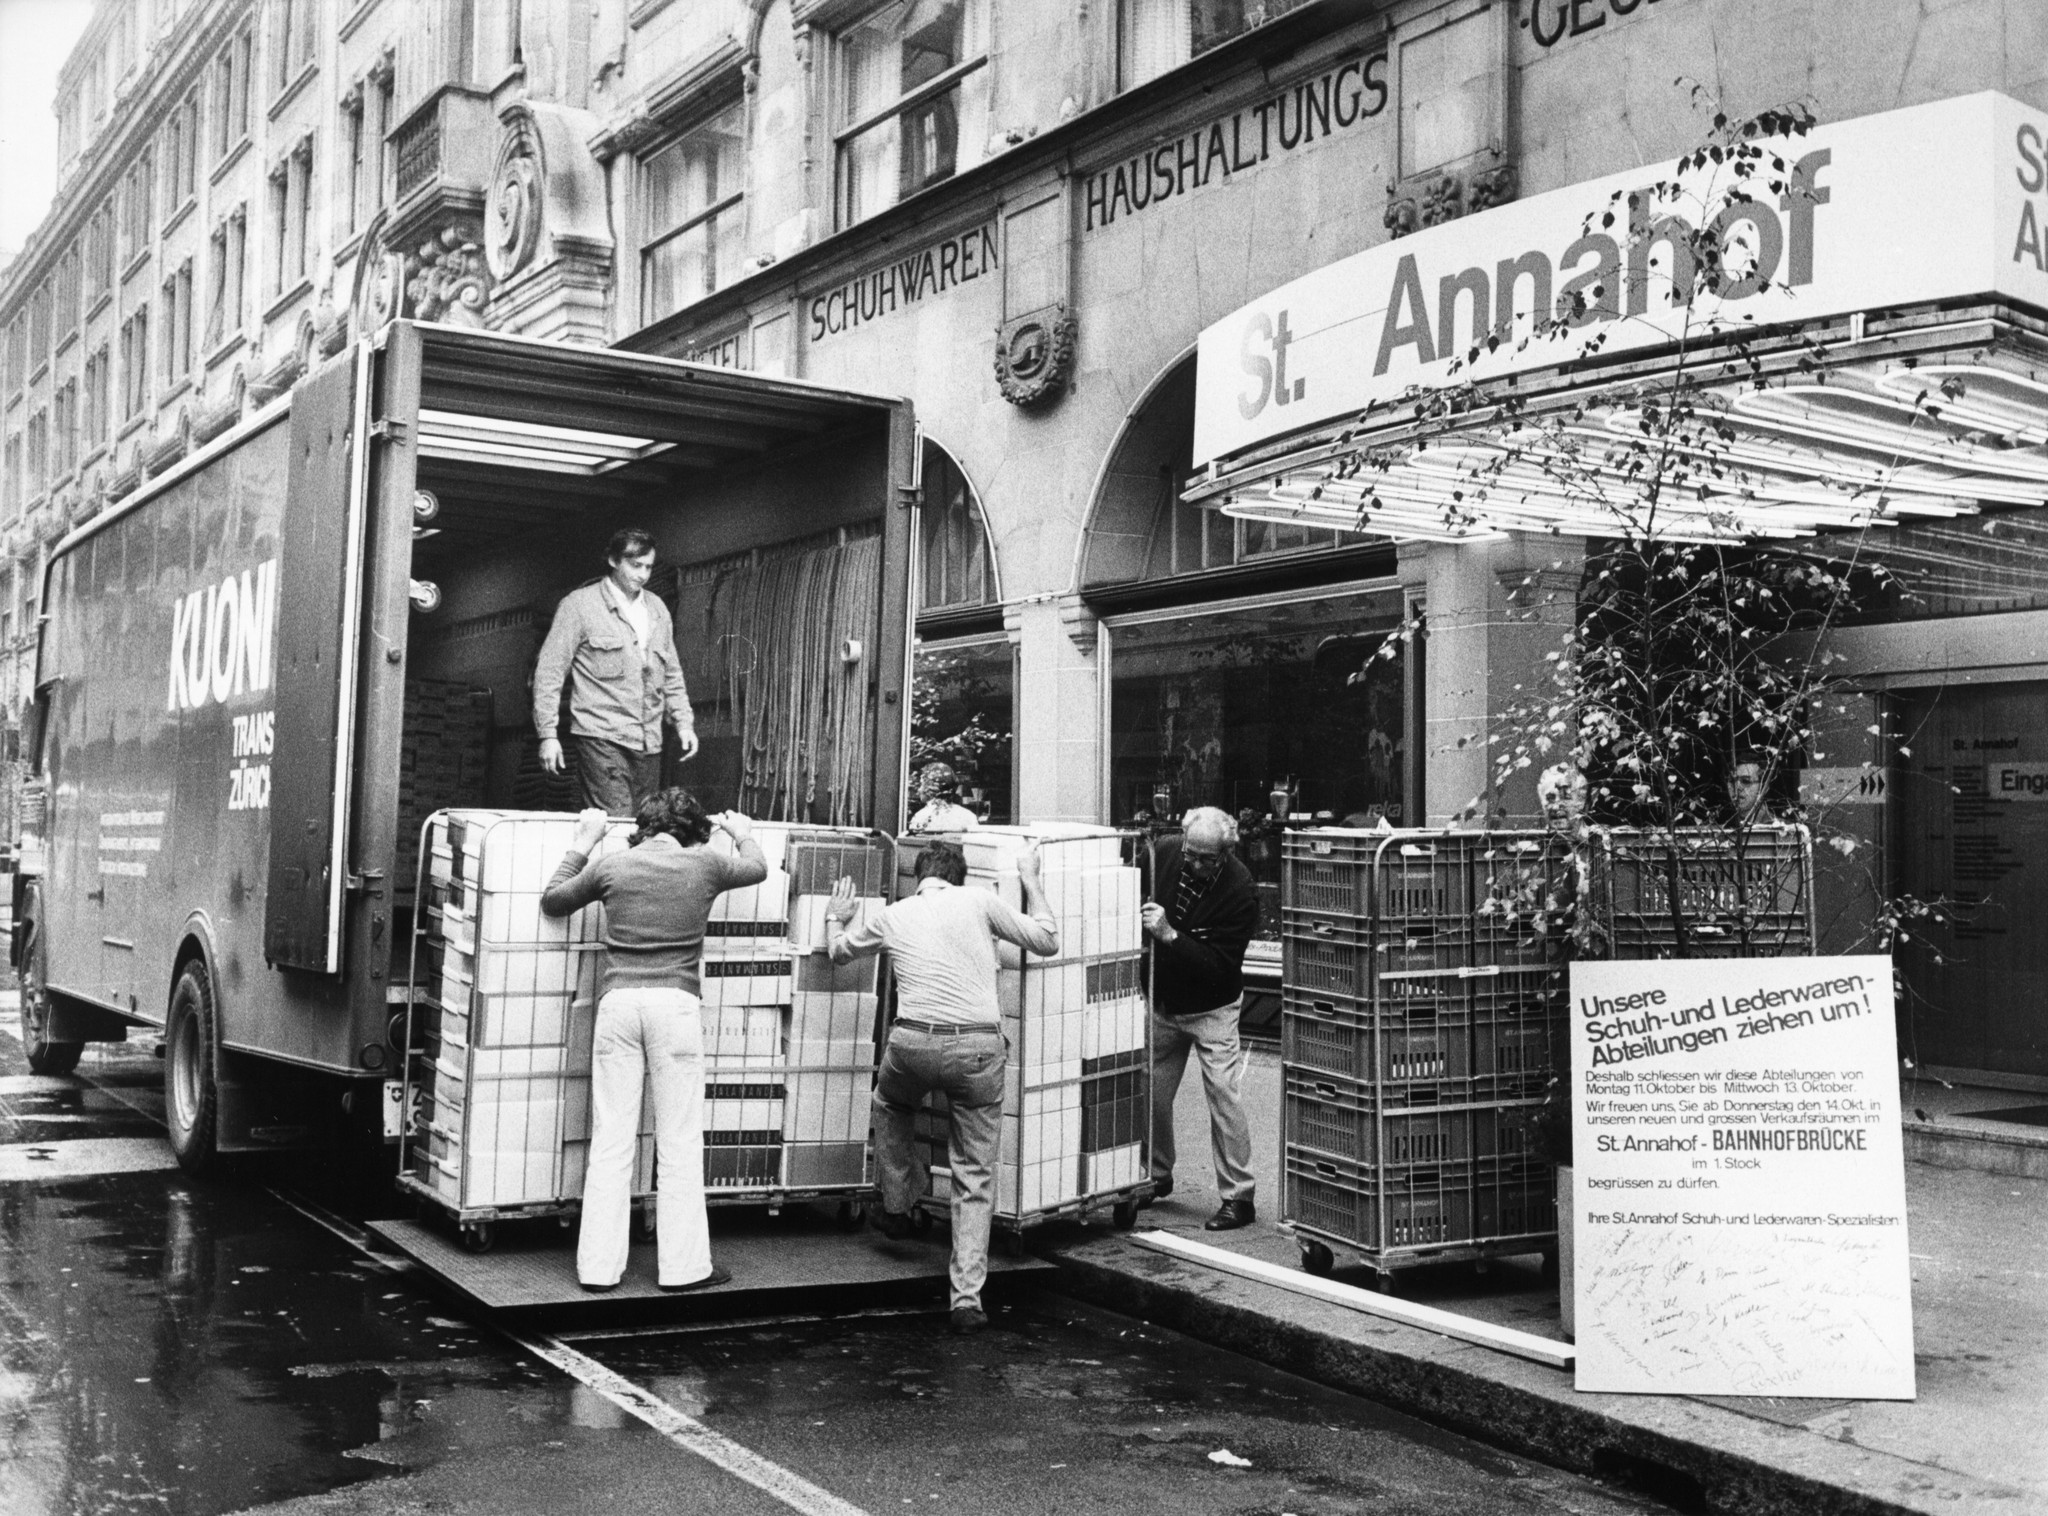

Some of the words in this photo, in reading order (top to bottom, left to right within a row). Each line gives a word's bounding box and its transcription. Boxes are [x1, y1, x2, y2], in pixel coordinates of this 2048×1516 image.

[1087, 57, 1388, 230] HAUSHALTUNGS
[811, 222, 999, 342] SCHUHWAREN
[1238, 310, 1305, 420] St.
[1372, 147, 1832, 378] Annahof
[168, 558, 277, 712] KUONI
[232, 710, 275, 757] TRANS
[2001, 769, 2048, 795] Eing
[1581, 989, 1666, 1017] Unsere
[1586, 999, 1716, 1043] Schuh-und
[1722, 975, 1874, 1015] Lederwaren-
[1591, 1024, 1728, 1067] Abteilungen
[1737, 1008, 1814, 1040] ziehen
[1586, 1071, 1634, 1082] Deshalb
[1638, 1071, 1699, 1081] schliessen
[1705, 1070, 1720, 1081] wir
[1726, 1070, 1757, 1081] diese
[1763, 1069, 1835, 1082] Abteilungen
[1841, 1071, 1863, 1080] von
[1587, 1083, 1630, 1096] Montag
[1700, 1083, 1716, 1093] bis
[1724, 1082, 1779, 1093] Mittwoch
[1587, 1101, 1606, 1112] Wir
[1609, 1101, 1647, 1112] freuen
[1652, 1102, 1676, 1113] uns,
[1679, 1100, 1698, 1111] Sie
[1704, 1100, 1718, 1111] ab
[1724, 1100, 1793, 1113] Donnerstag
[1798, 1100, 1821, 1110] den
[1870, 1099, 1880, 1110] in
[1587, 1114, 1635, 1125] unseren
[1640, 1114, 1676, 1124] neuen
[1681, 1113, 1703, 1124] und
[1708, 1113, 1756, 1125] grossen
[1760, 1112, 1860, 1124] Verkaufsräumen
[1865, 1113, 1880, 1123] im
[1713, 1127, 1866, 1151] BAHNHOFBRÜCKE
[1692, 1158, 1707, 1169] im
[1714, 1158, 1721, 1169] 1.
[1725, 1158, 1761, 1169] Stock
[1588, 1177, 1653, 1190] begrüssen
[1658, 1180, 1672, 1188] zu
[1677, 1177, 1720, 1189] dürfen.
[1588, 1213, 1610, 1224] Ihre
